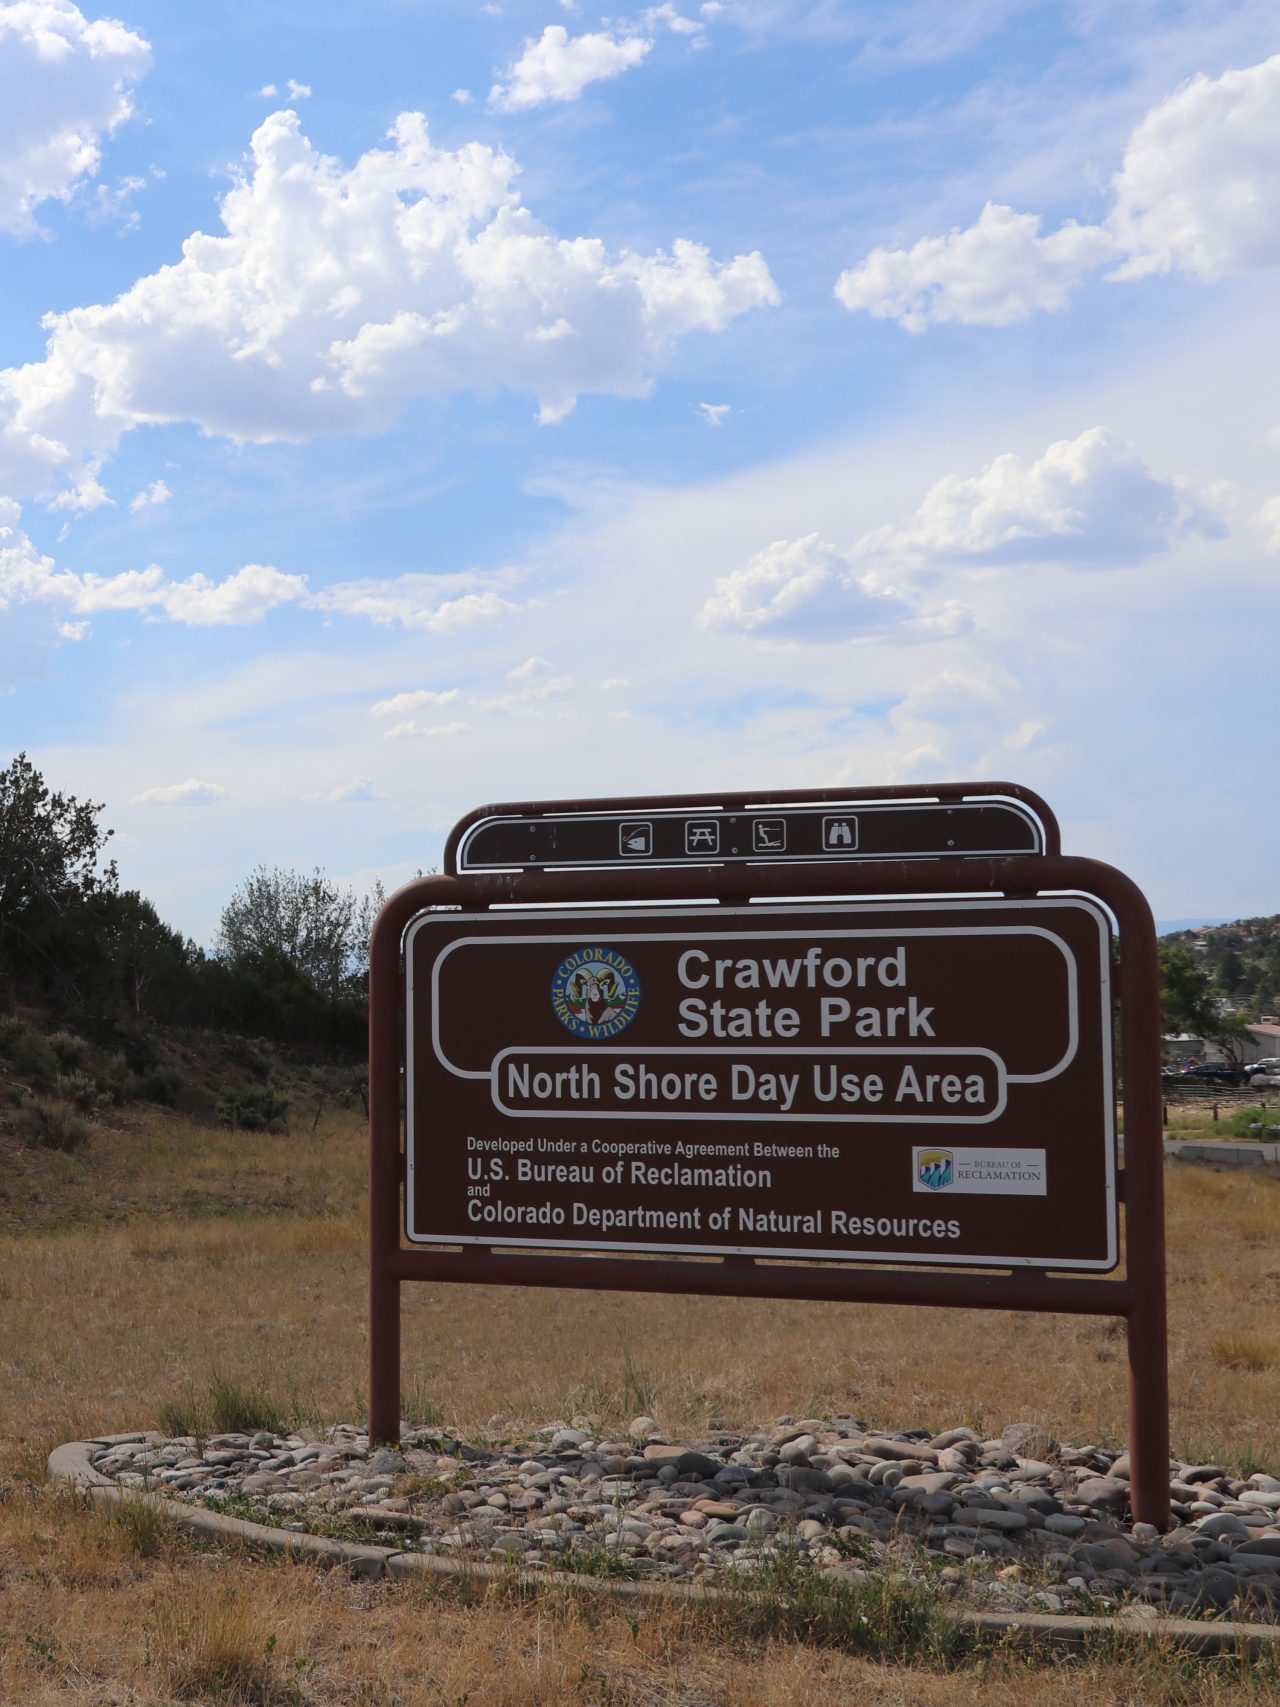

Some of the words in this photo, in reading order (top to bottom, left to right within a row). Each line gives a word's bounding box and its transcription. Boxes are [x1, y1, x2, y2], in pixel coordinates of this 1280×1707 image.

[558, 948, 633, 978] COLORADO
[678, 947, 906, 989] Crawford
[553, 988, 579, 1030] PARKS
[588, 987, 640, 1038] WILDLIFE
[678, 998, 800, 1037] State
[821, 997, 936, 1037] Park
[509, 1064, 600, 1098] North
[614, 1064, 717, 1100] Shore
[732, 1065, 799, 1110] Day
[814, 1065, 883, 1102] Use
[895, 1065, 985, 1103] Area
[468, 1137, 533, 1154] Developed
[538, 1138, 576, 1152] Under
[581, 1143, 587, 1152] a
[592, 1139, 671, 1156] Cooperative
[675, 1141, 749, 1158] Agreement
[754, 1143, 812, 1157] Between
[817, 1144, 839, 1158] the
[468, 1158, 509, 1180] U.S.
[518, 1159, 593, 1182] Bureau
[602, 1161, 624, 1183] of
[632, 1162, 771, 1187] Reclamation
[958, 1171, 1040, 1180] RECLAMATION
[974, 1160, 1008, 1168] BUREAU
[468, 1183, 490, 1196] and
[468, 1199, 564, 1224] Colorado
[573, 1203, 701, 1231] Department
[709, 1207, 731, 1230] of
[739, 1208, 821, 1233] Natural
[832, 1211, 960, 1238] Resources
